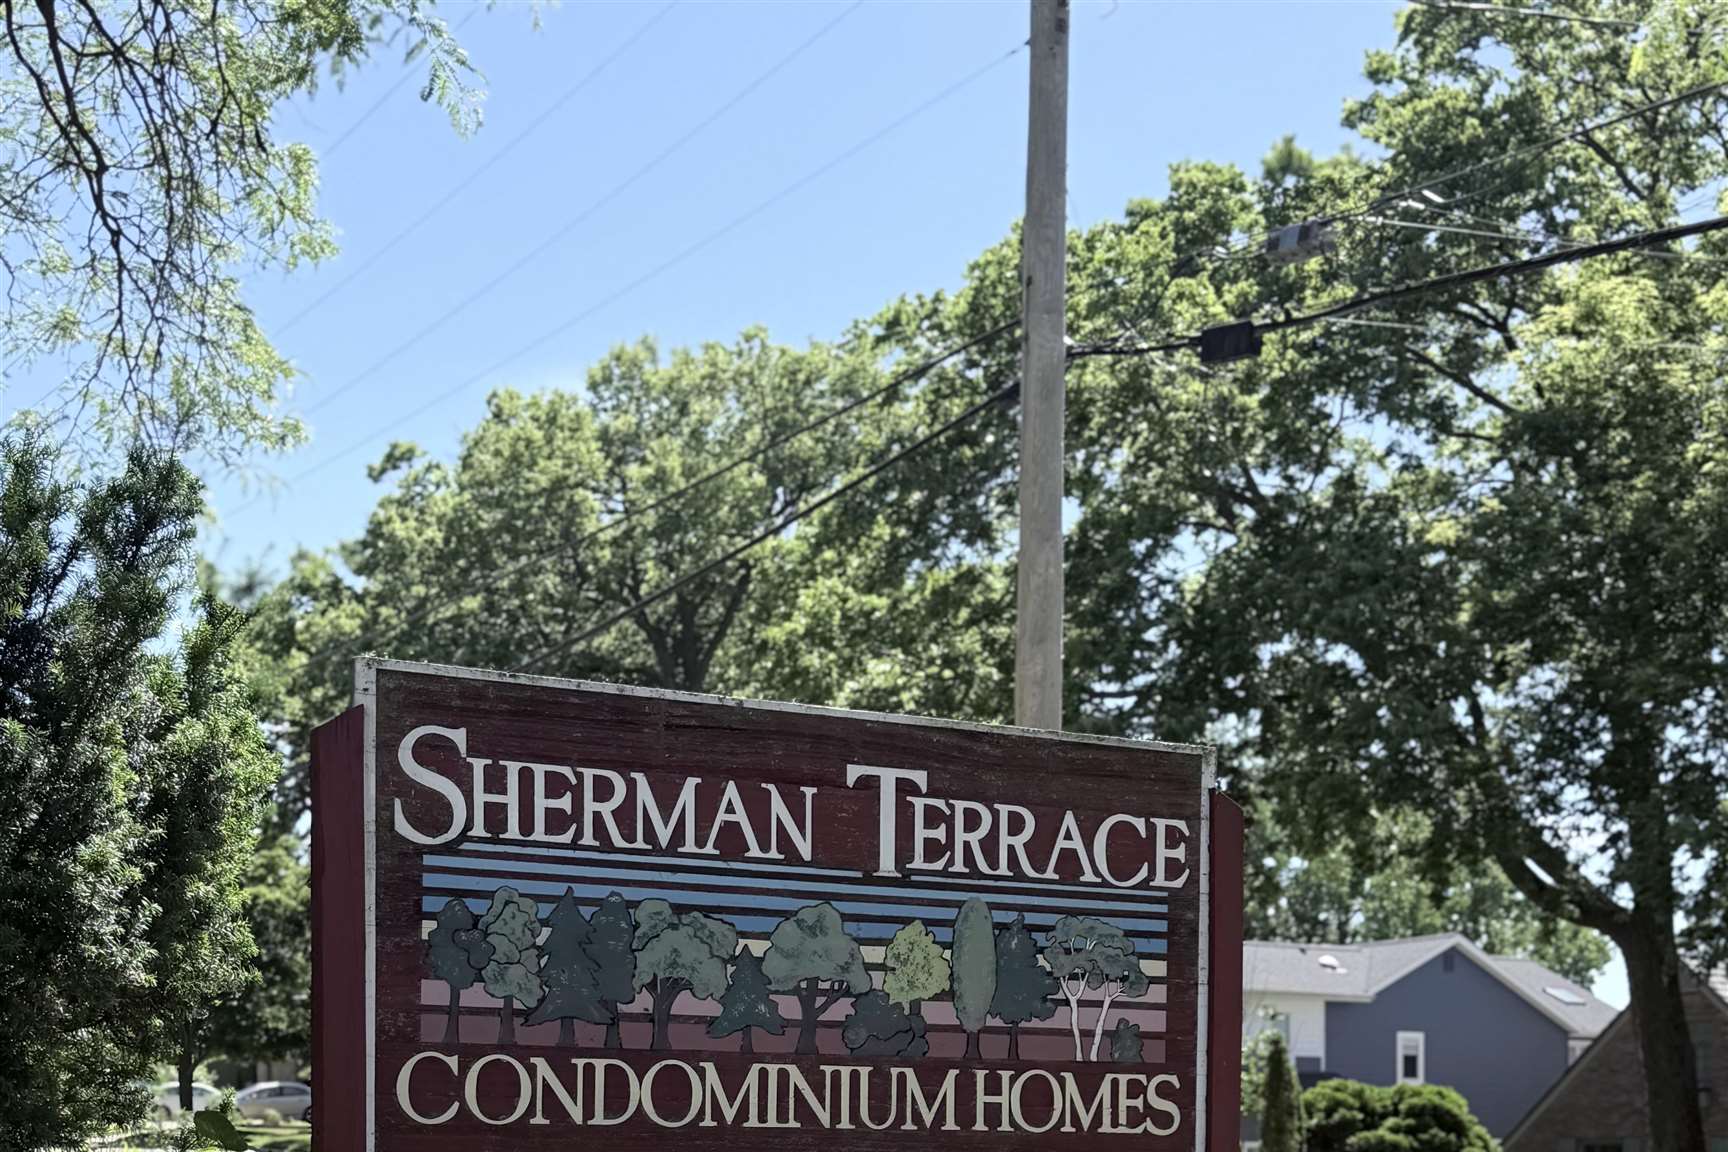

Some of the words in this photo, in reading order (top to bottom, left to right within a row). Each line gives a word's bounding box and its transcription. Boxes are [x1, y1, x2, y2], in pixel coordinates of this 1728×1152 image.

[393, 724, 818, 862] SHERMAN
[846, 763, 1191, 889] TERRACE
[395, 1051, 960, 1131] CONDOMINIUM
[971, 1068, 1181, 1136] HOMES
